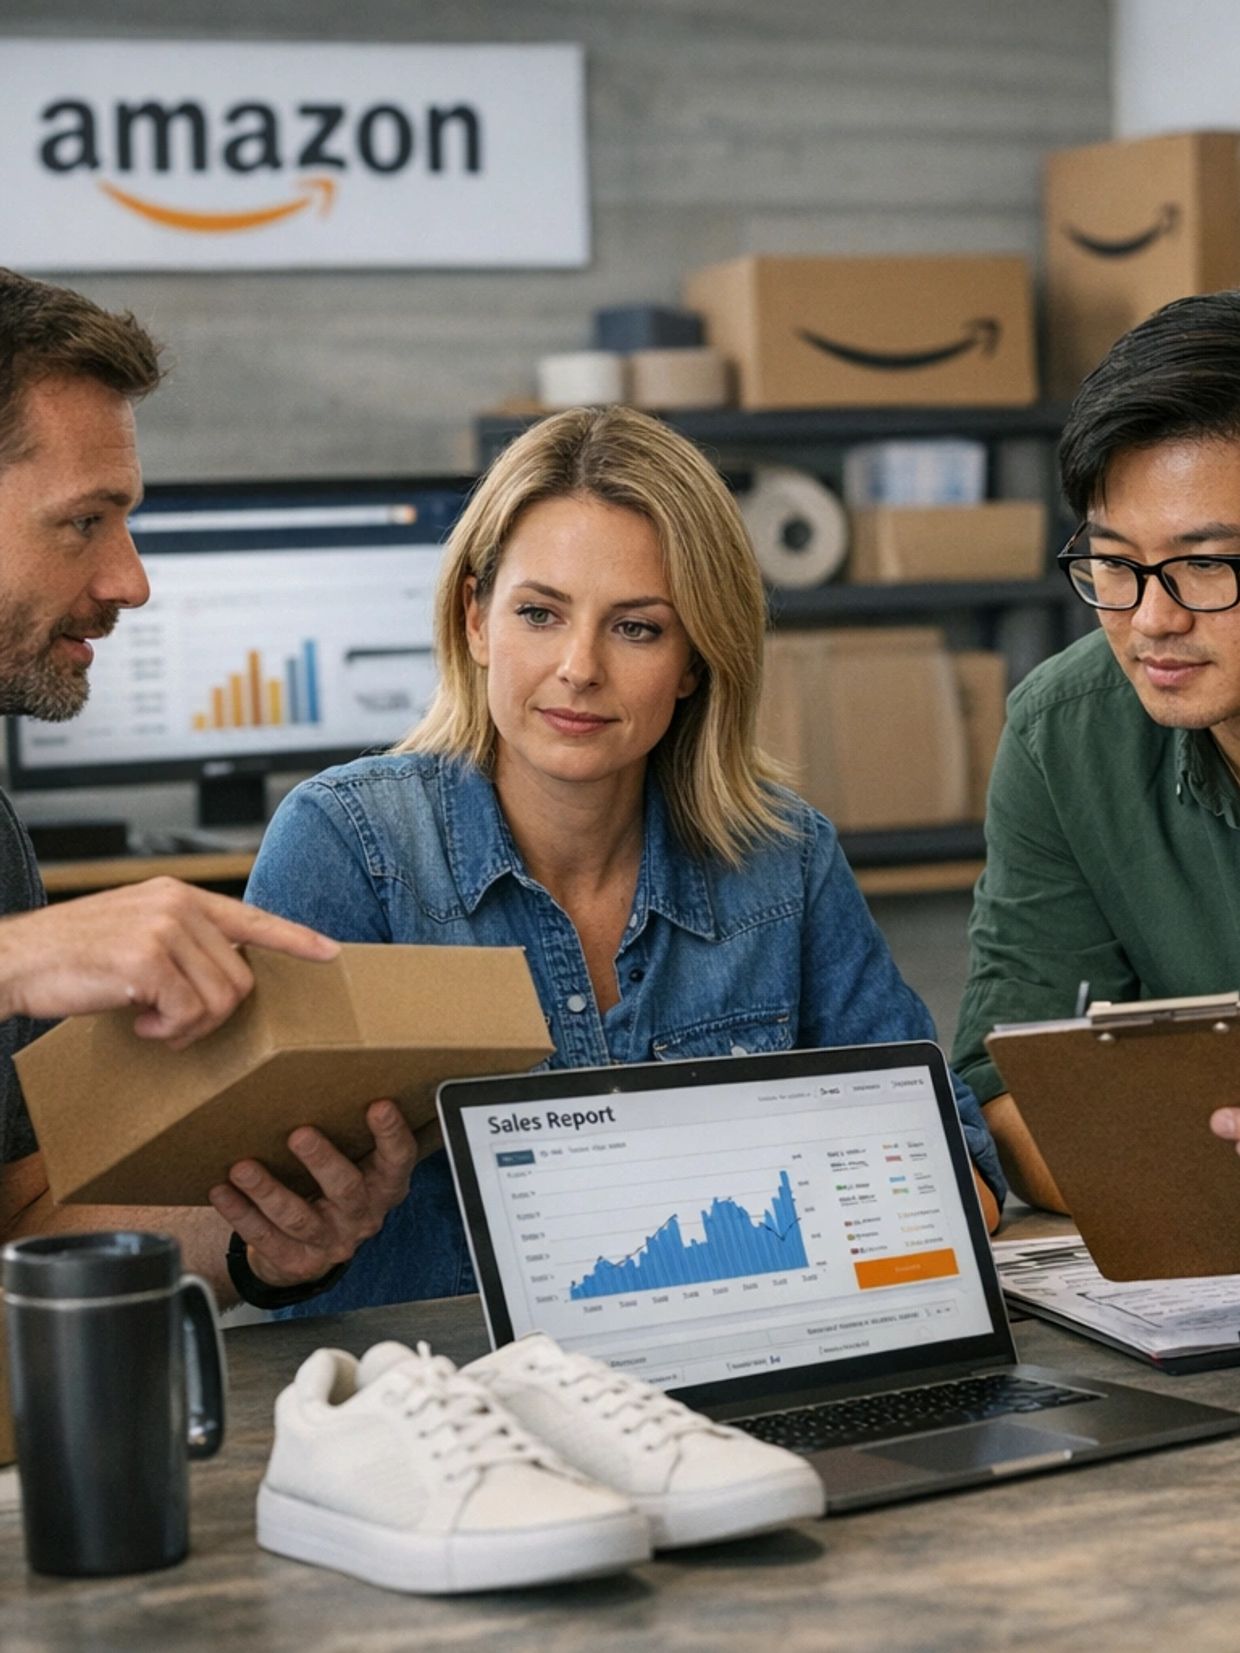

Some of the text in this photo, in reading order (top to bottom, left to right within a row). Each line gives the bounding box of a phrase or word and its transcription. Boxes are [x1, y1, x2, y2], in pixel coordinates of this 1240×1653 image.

[39, 97, 483, 175] amazon
[488, 1106, 616, 1135] Sales Report
